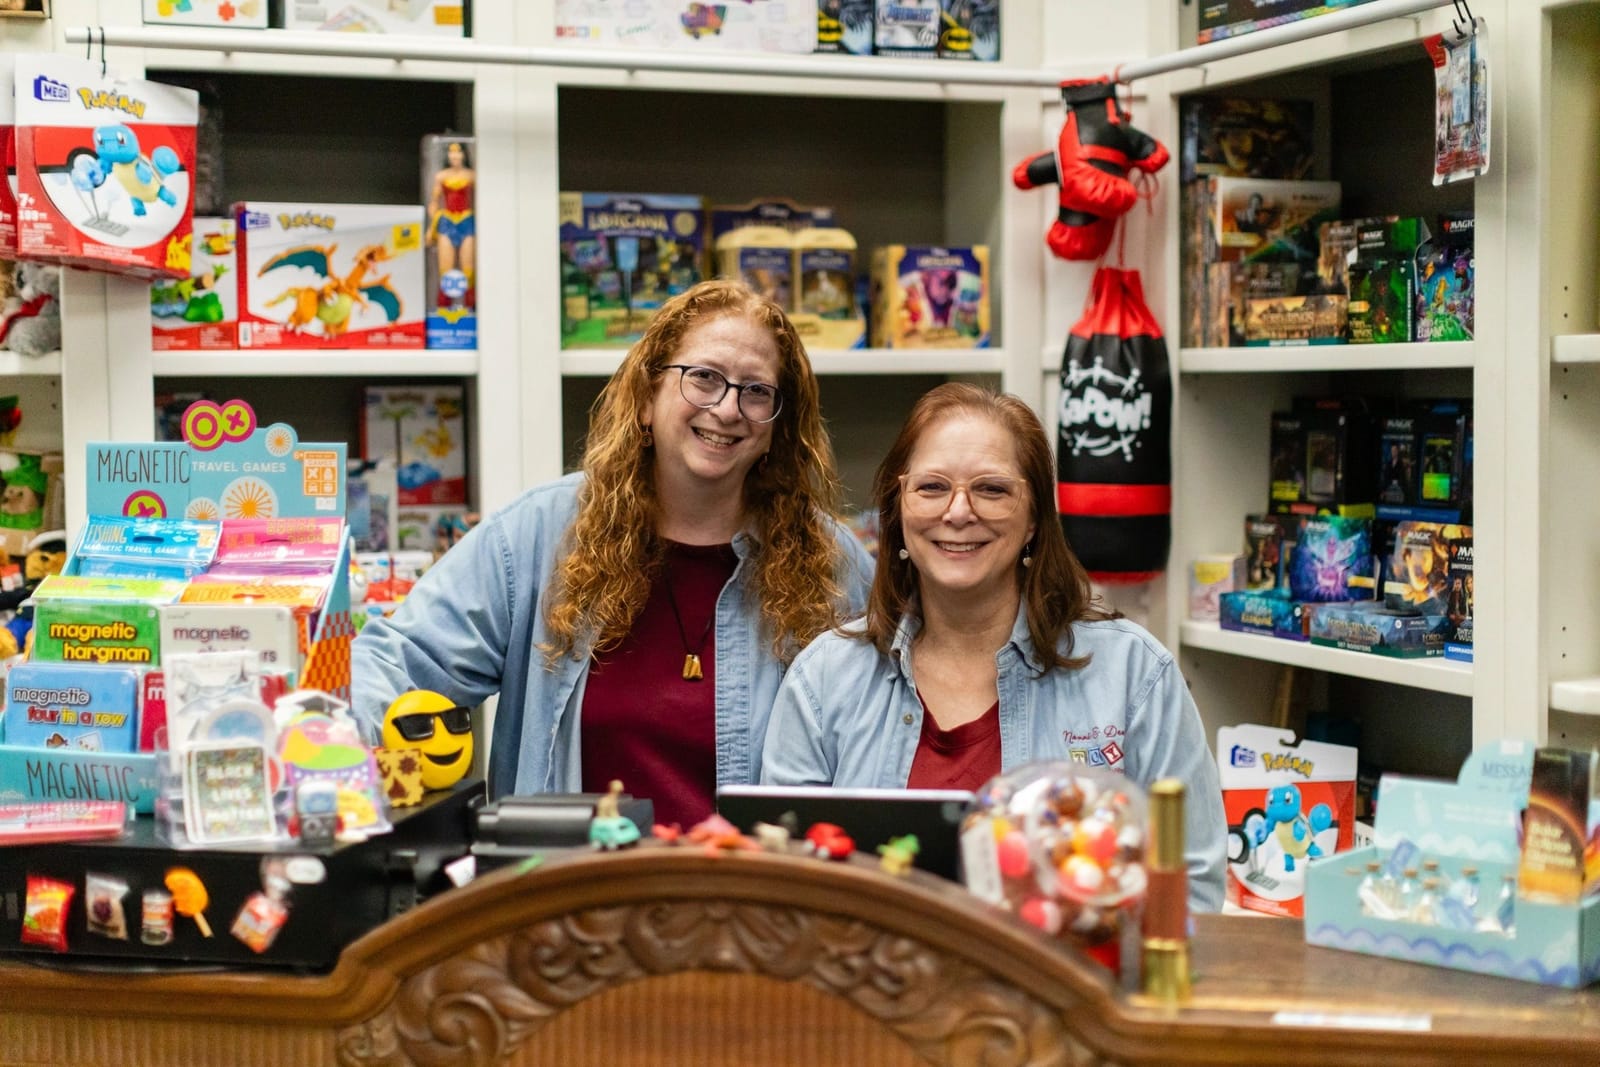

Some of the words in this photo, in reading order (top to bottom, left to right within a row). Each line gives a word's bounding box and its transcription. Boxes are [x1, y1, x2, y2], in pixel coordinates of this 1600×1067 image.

[43, 84, 69, 99] MEGA
[97, 449, 191, 484] MAGNETIC
[192, 461, 238, 473] TRAVEL
[243, 461, 287, 473] GAMES
[84, 525, 128, 545] FISHING
[83, 543, 122, 553] MAGNETIC
[124, 546, 153, 555] TRAVEL
[154, 547, 178, 555] GAME
[50, 622, 136, 642] magnetic
[173, 626, 249, 643] magnetic
[63, 642, 150, 664] hangman
[12, 687, 91, 706] magnetic
[27, 706, 59, 725] four
[61, 706, 78, 725] in
[80, 711, 93, 725] a
[95, 711, 128, 728] row
[1481, 760, 1530, 778] MESSA
[26, 759, 139, 803] MAGNETIC
